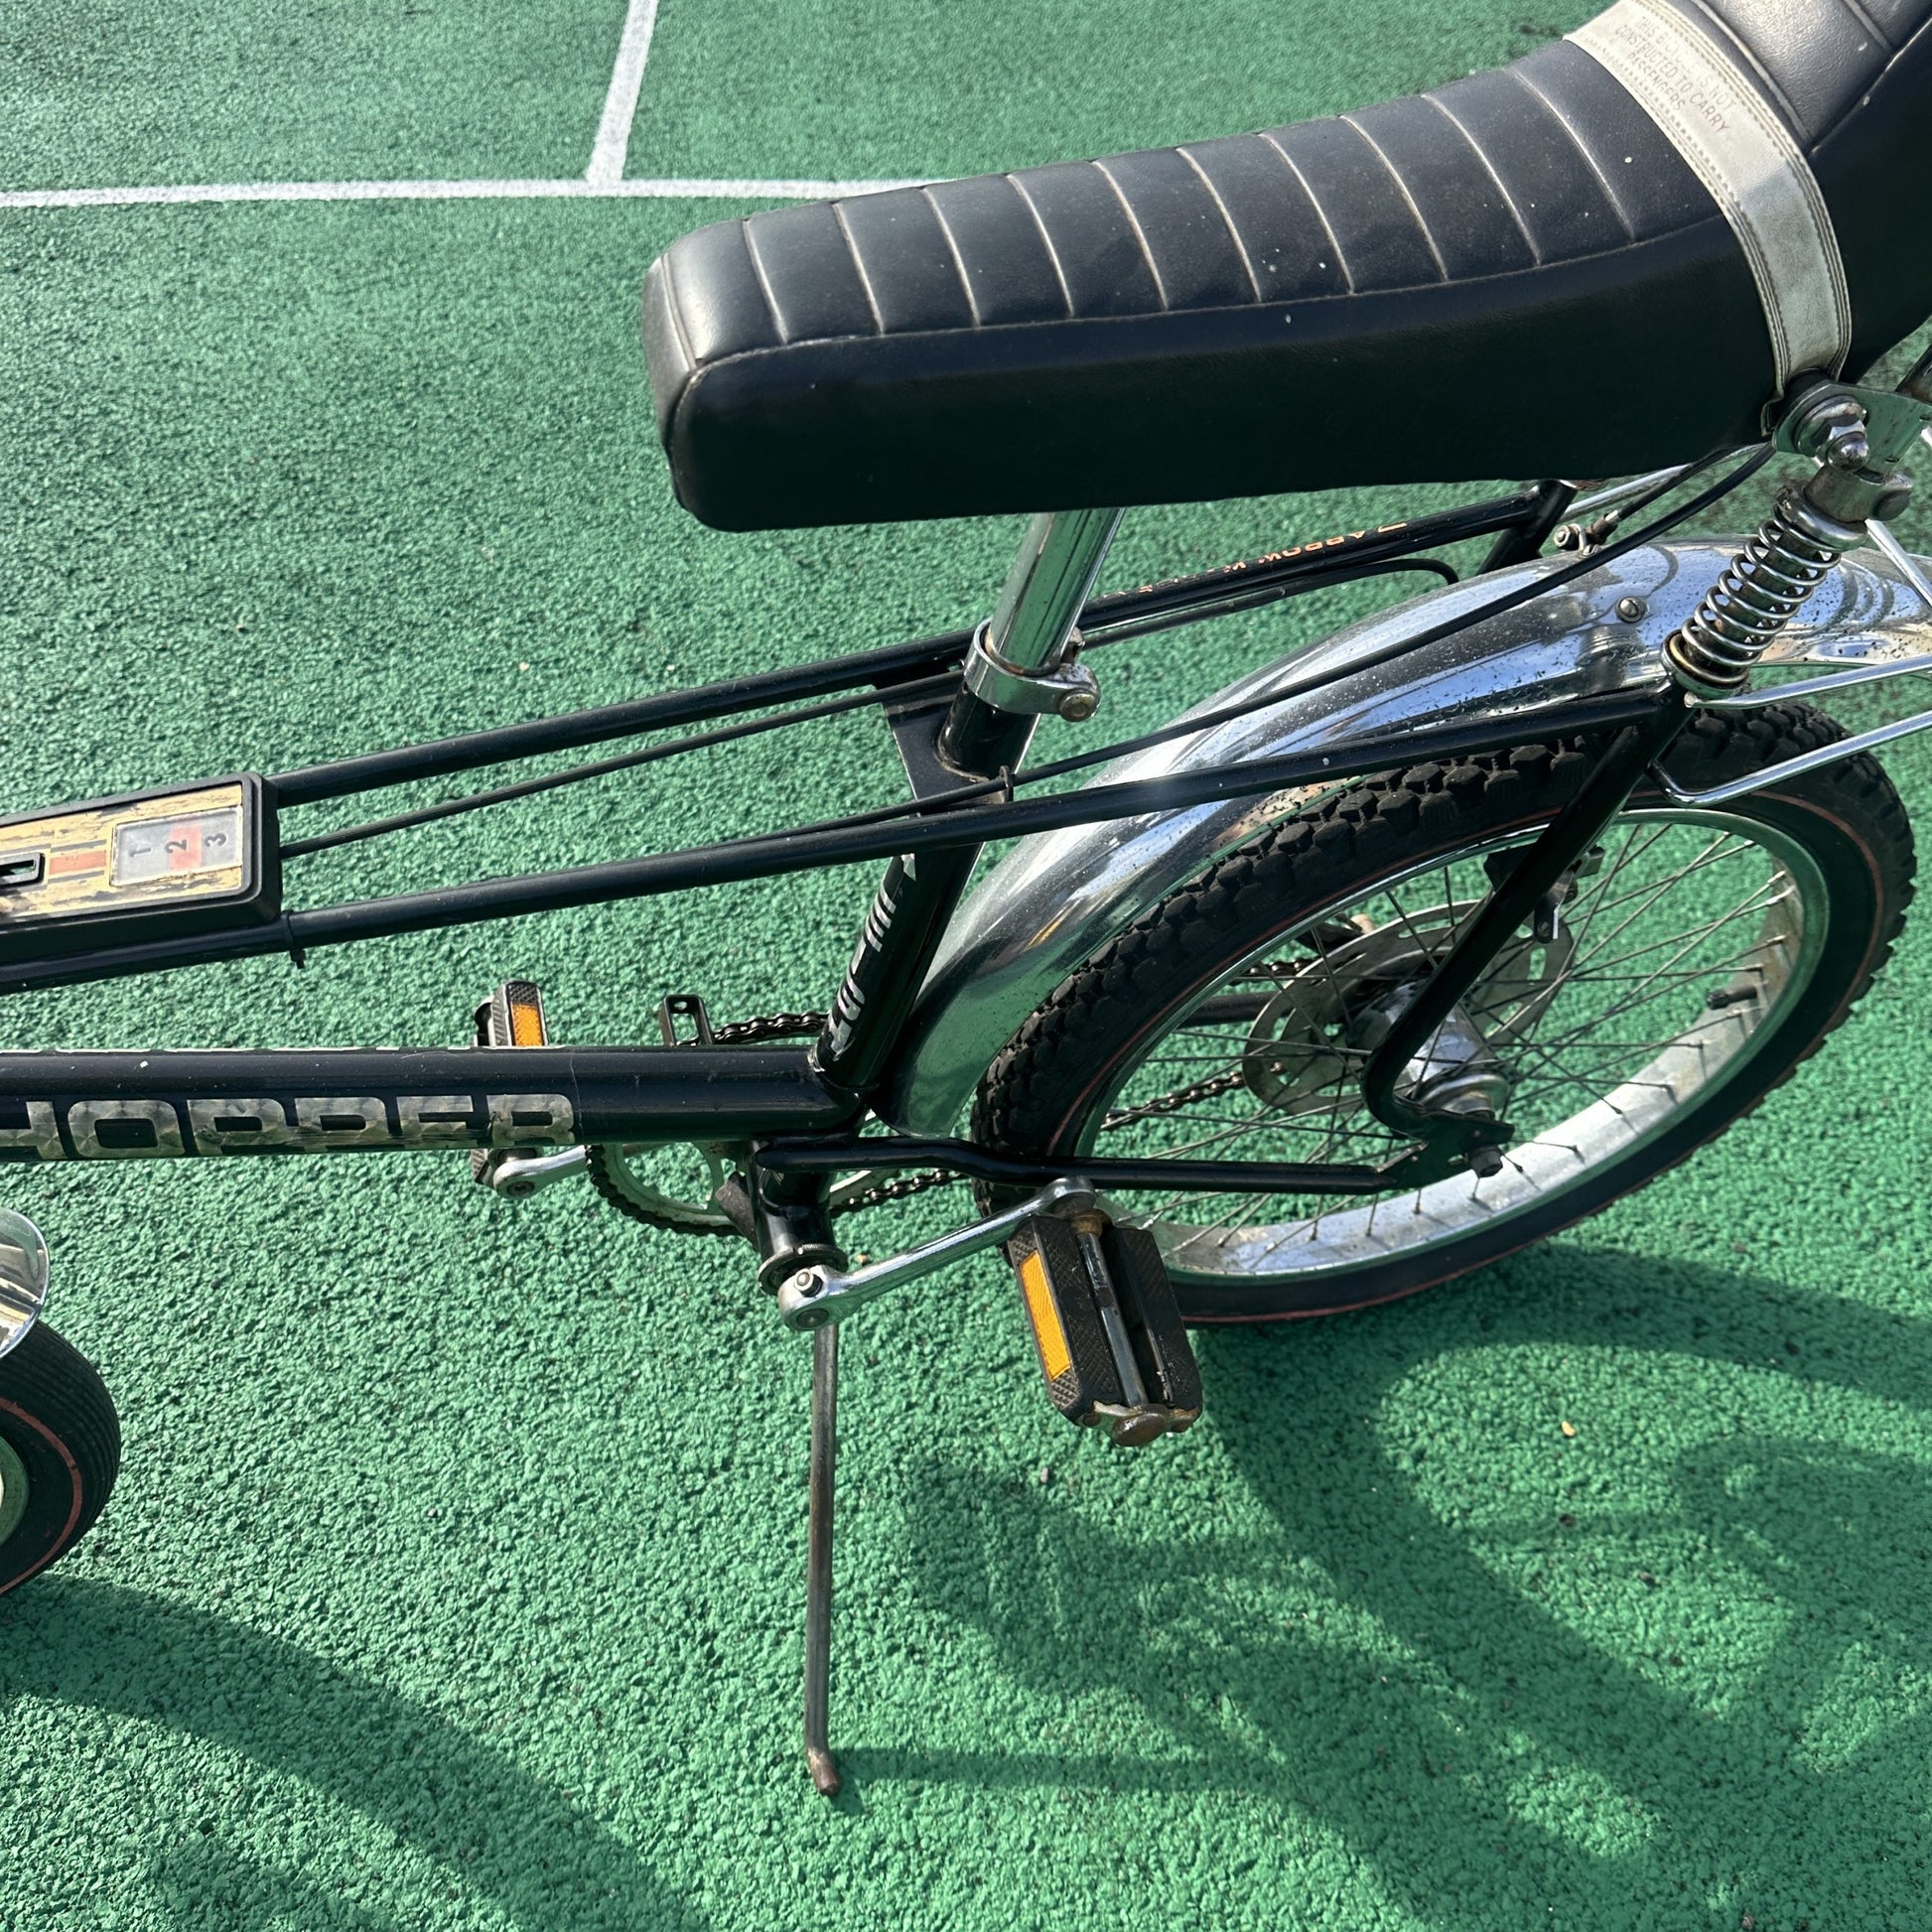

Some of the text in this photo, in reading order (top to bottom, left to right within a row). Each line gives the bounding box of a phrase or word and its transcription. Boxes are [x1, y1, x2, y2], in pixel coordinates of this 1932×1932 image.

[1614, 24, 1730, 133] CONSTRUCTED TO CARRY
[1625, 52, 1686, 110] PASSENGERS
[1637, 16, 1660, 38] THIS
[1709, 85, 1736, 112] NOT
[127, 832, 227, 858] 1 2 3
